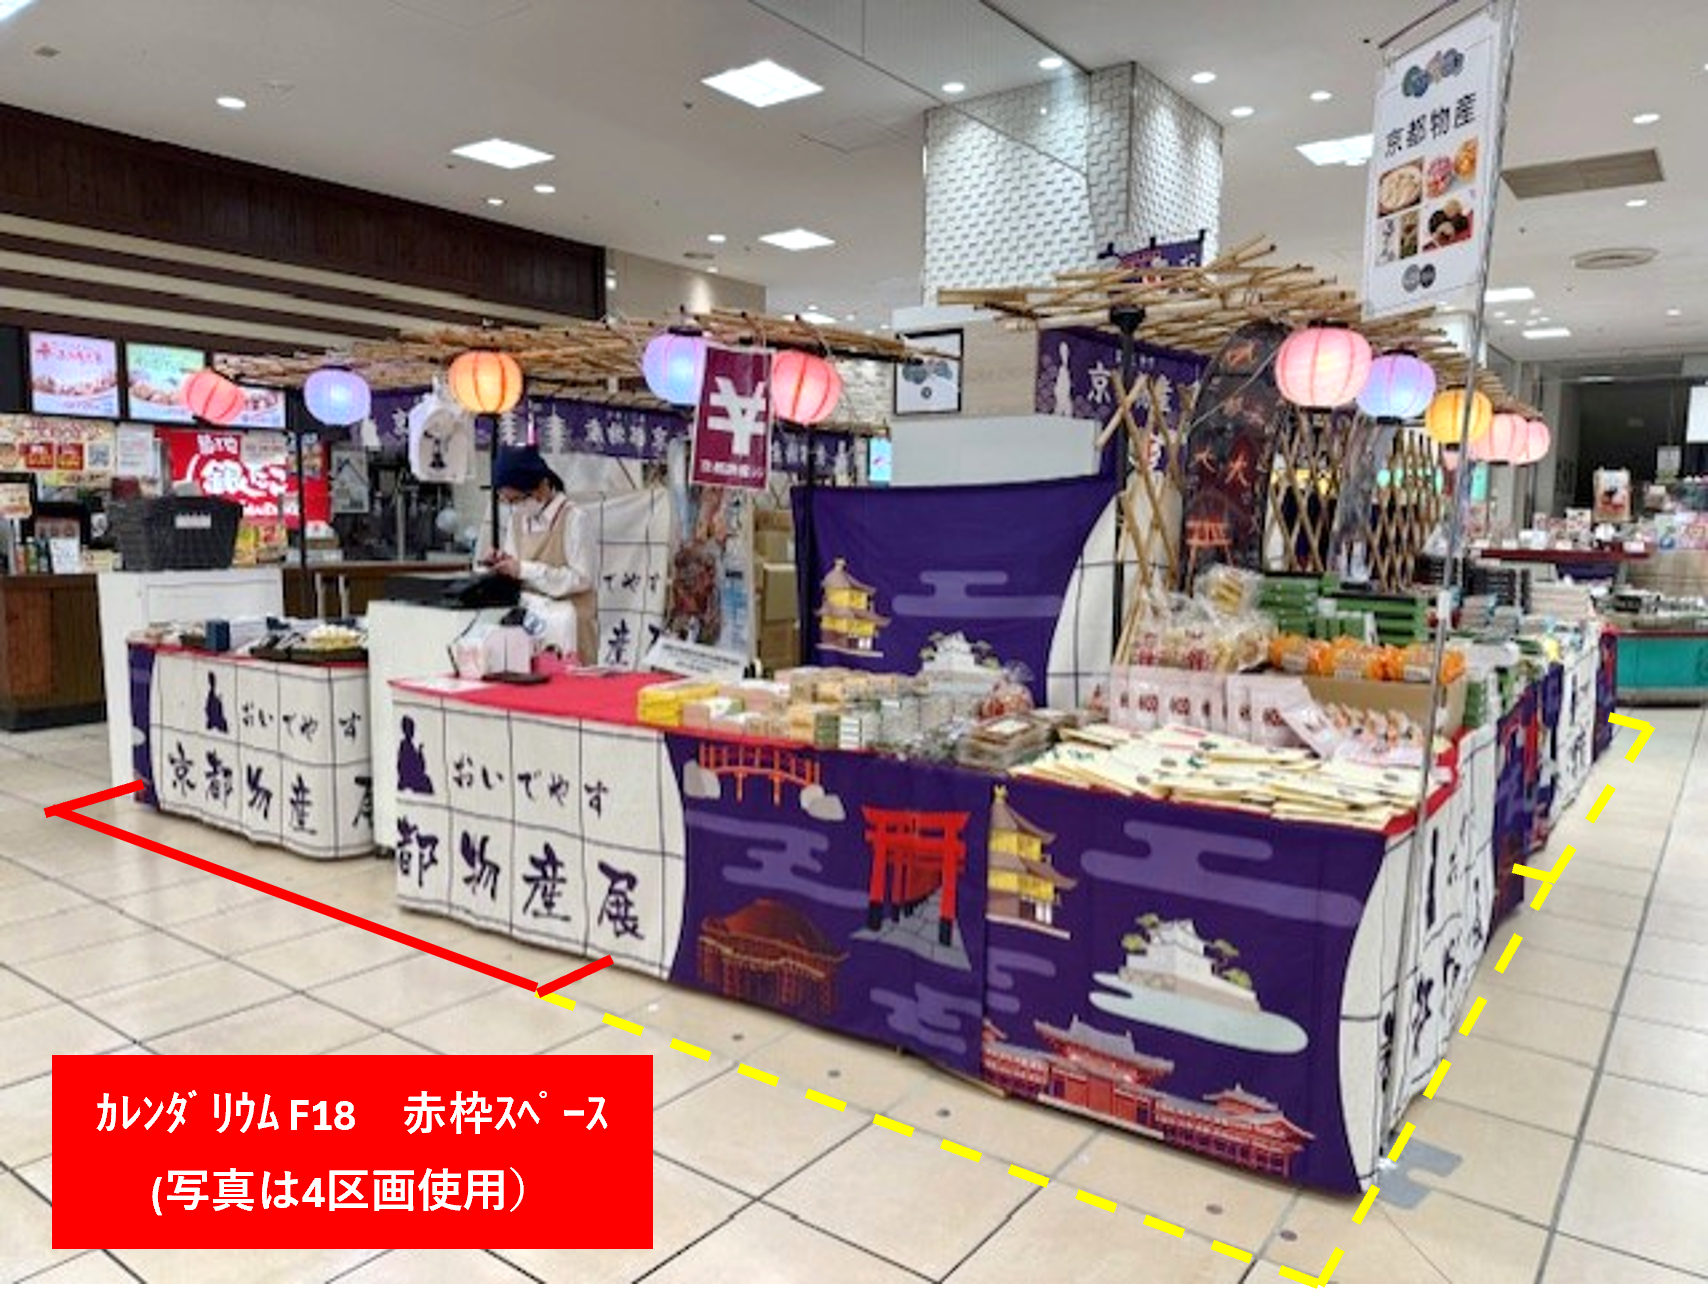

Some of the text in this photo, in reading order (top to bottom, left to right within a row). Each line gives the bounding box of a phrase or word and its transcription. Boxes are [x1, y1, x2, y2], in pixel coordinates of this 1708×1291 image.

[1385, 92, 1476, 158] 京都物産
[242, 702, 361, 742] おいでやす
[453, 756, 609, 818] おいでやす
[396, 815, 644, 940] 都物産展
